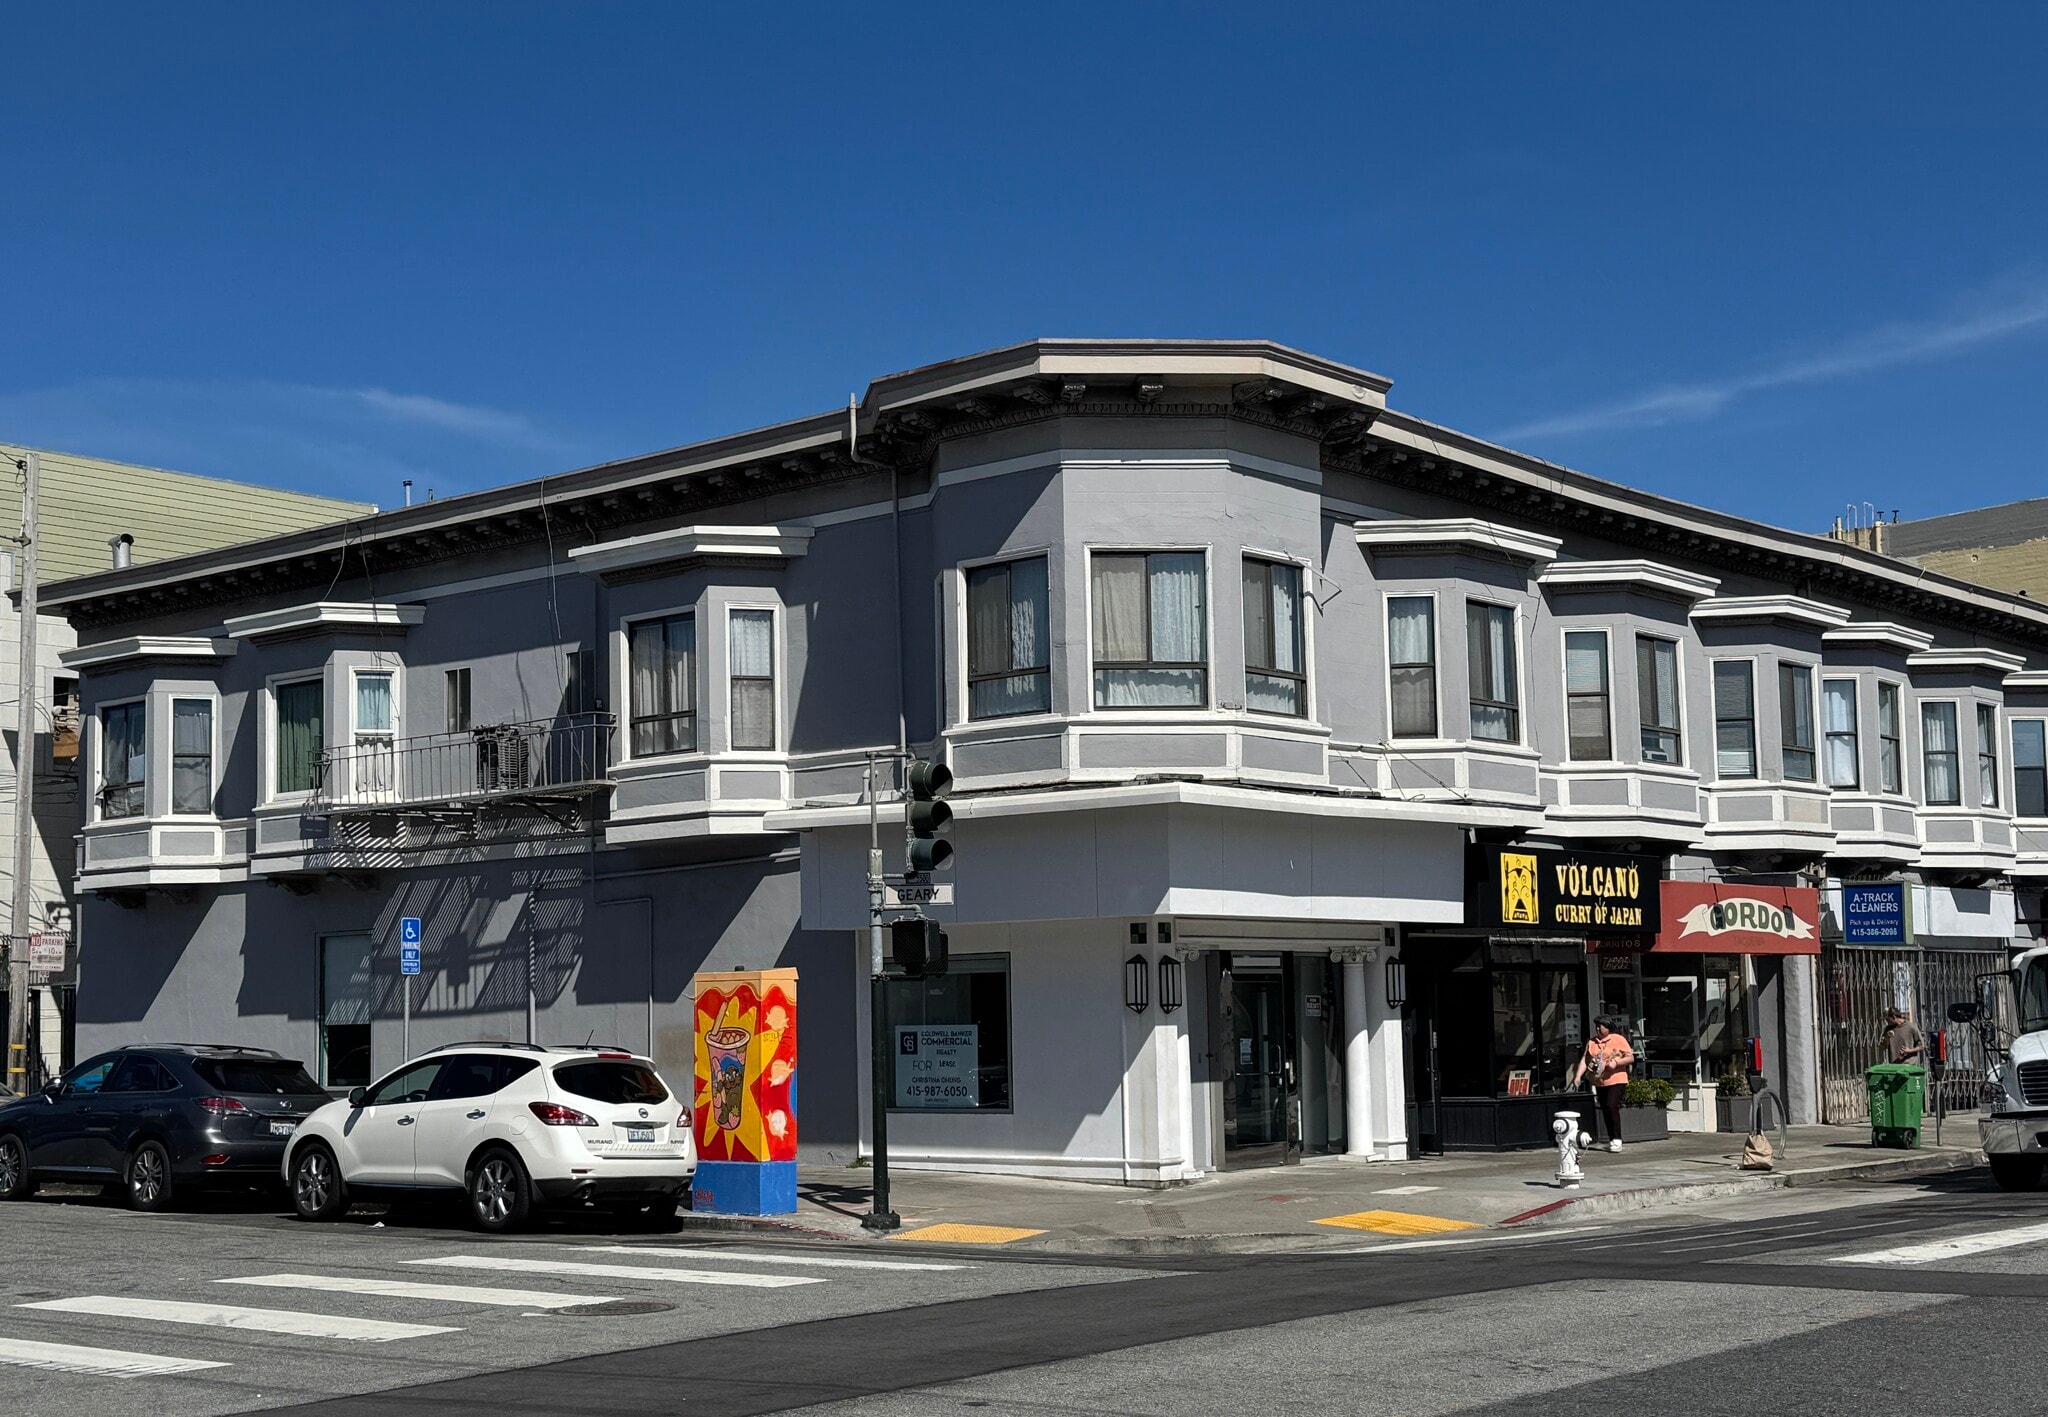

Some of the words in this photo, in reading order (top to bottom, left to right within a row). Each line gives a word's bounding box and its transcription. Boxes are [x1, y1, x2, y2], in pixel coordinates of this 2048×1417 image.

[1555, 860, 1640, 899] VOLCANO
[897, 887, 940, 901] GEARY
[1853, 892, 1895, 903] A-TRACK
[1849, 903, 1899, 913] CLEANERS
[1555, 904, 1592, 924] CURRY
[1594, 903, 1607, 925] OF
[1610, 906, 1642, 926] JAPAN
[1876, 919, 1899, 927] Delivery
[31, 936, 41, 946] NO
[42, 938, 64, 946] PARKING
[920, 1037, 973, 1046] COMMERCIAL
[912, 1060, 933, 1071] FOR
[906, 1085, 968, 1097] 415-987-6050
[1509, 1078, 1529, 1096] OPEN
